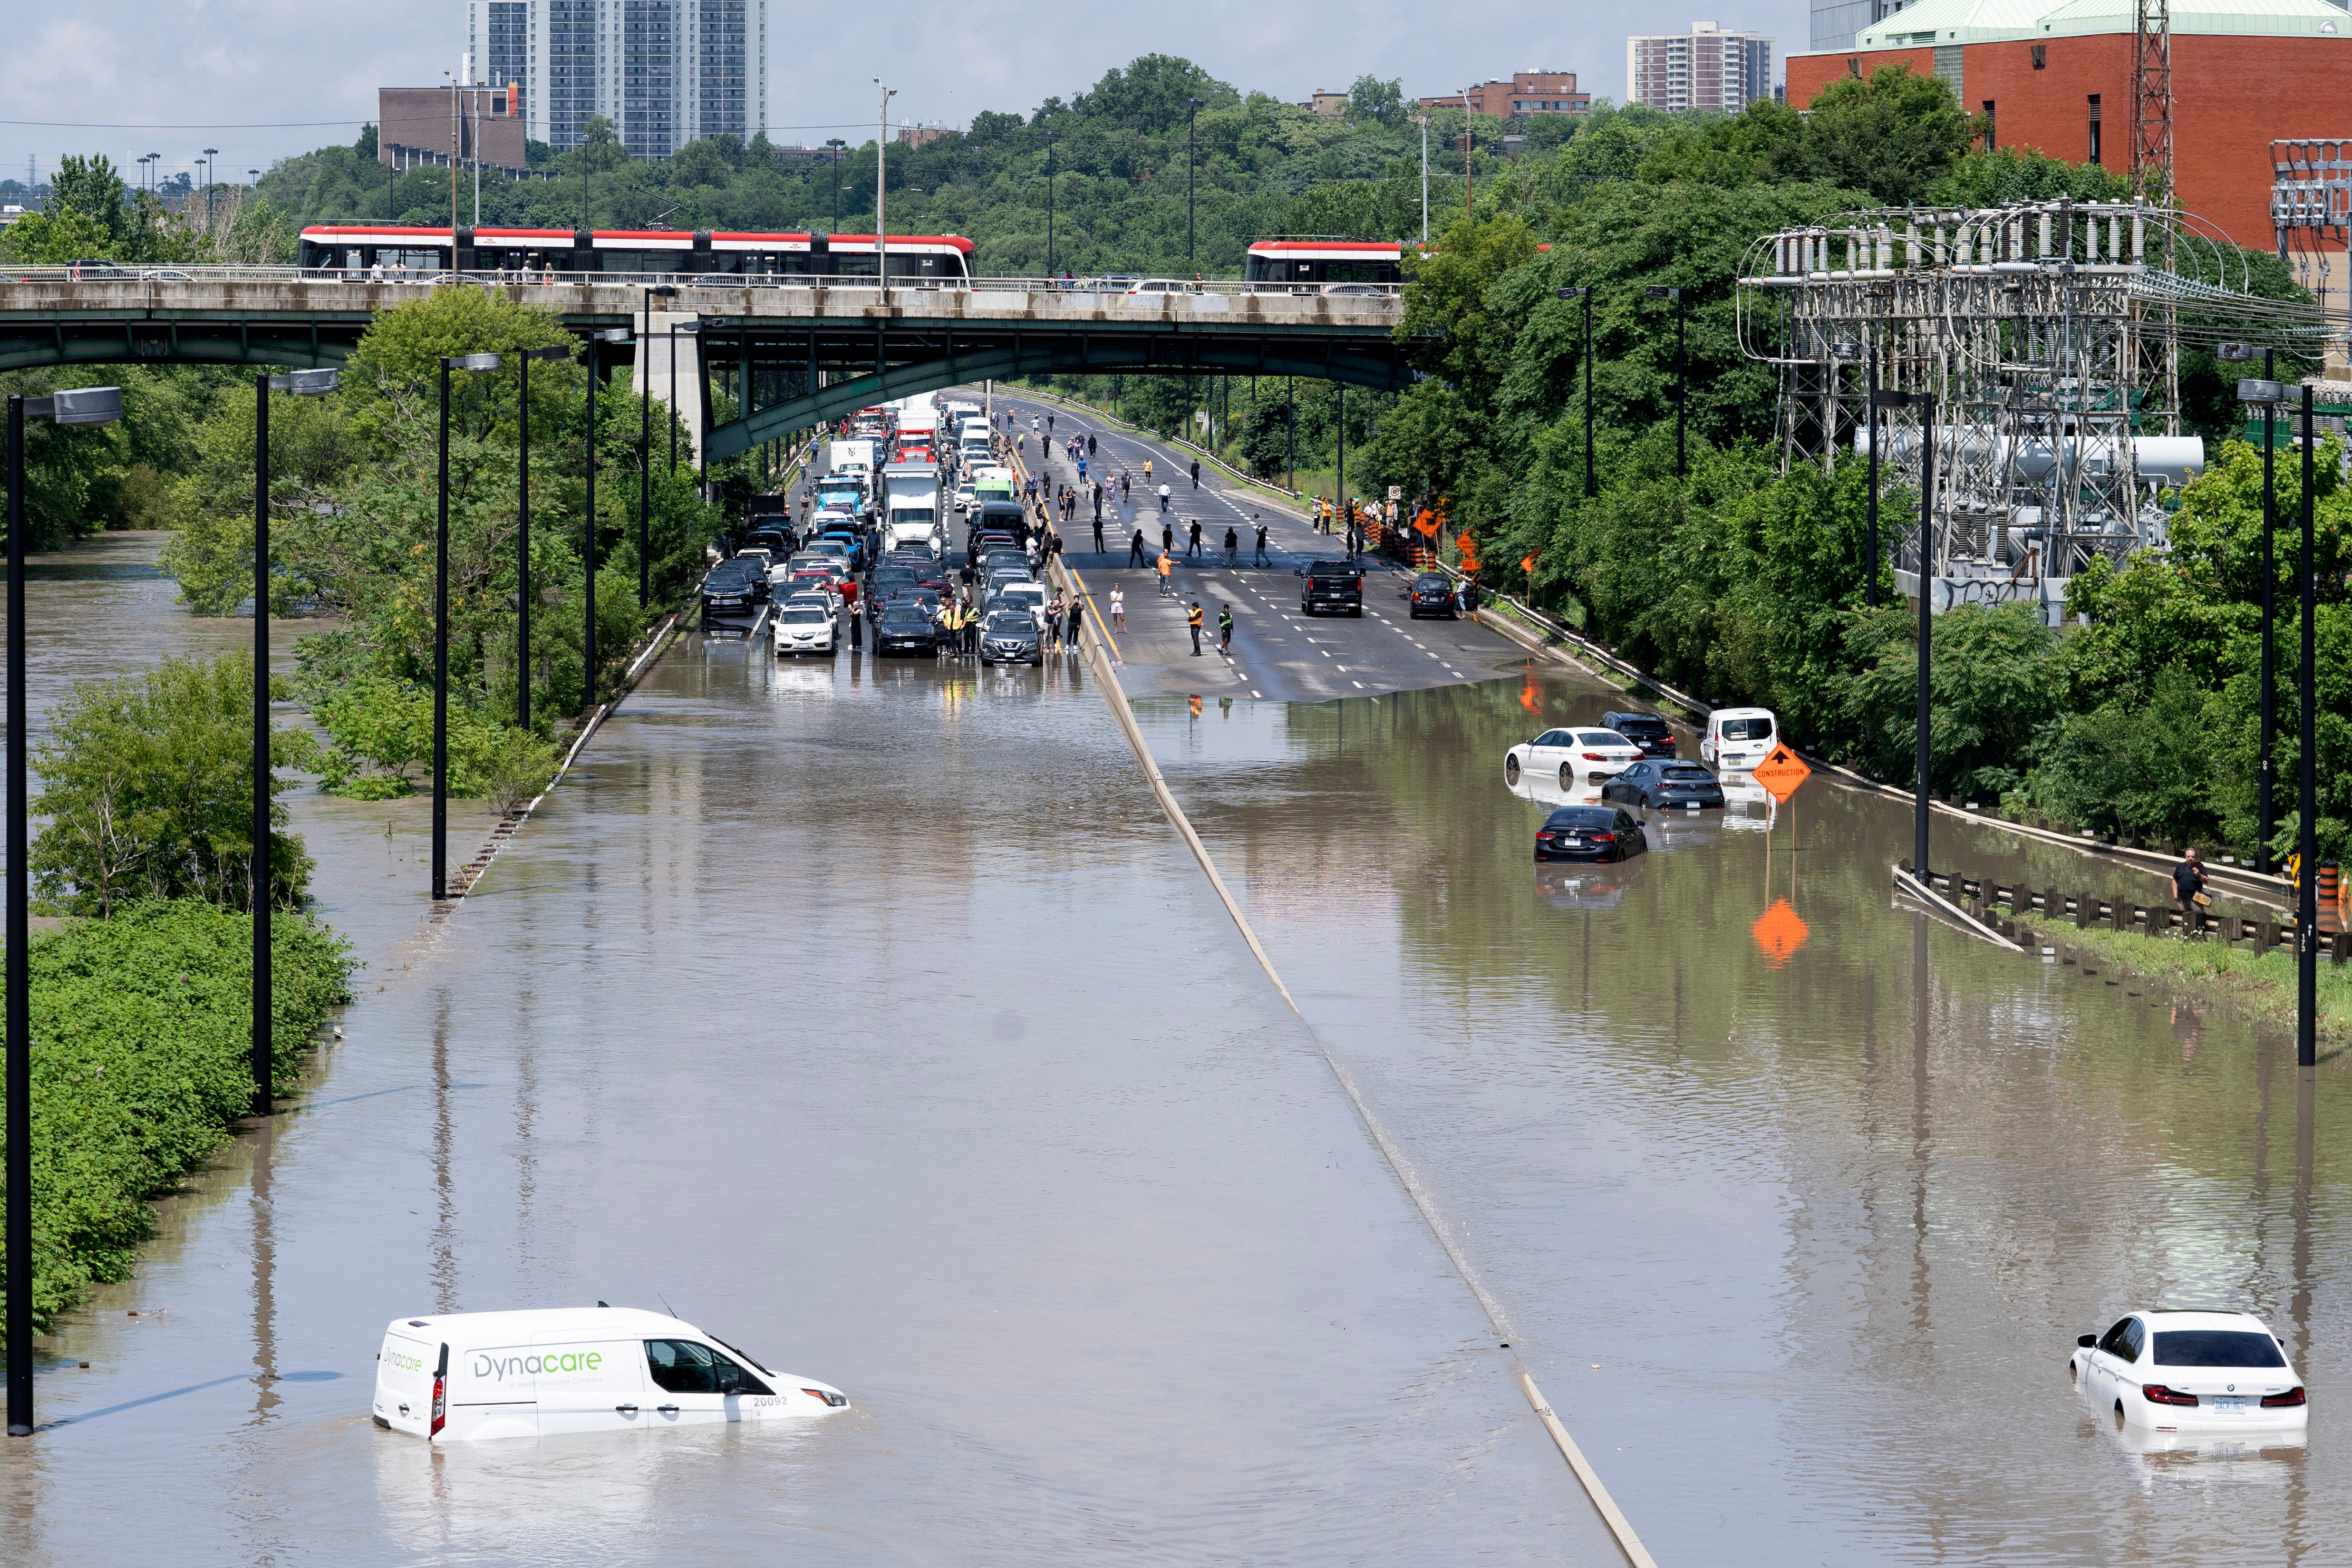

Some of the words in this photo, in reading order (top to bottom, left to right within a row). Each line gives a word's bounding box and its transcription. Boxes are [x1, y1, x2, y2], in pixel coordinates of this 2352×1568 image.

[1758, 768, 1804, 778] CONSTRUCTION
[384, 1346, 422, 1372] Dynacare
[474, 1352, 602, 1382] Dynacare
[754, 1396, 788, 1407] 20092
[2233, 1401, 2244, 1410] 867
